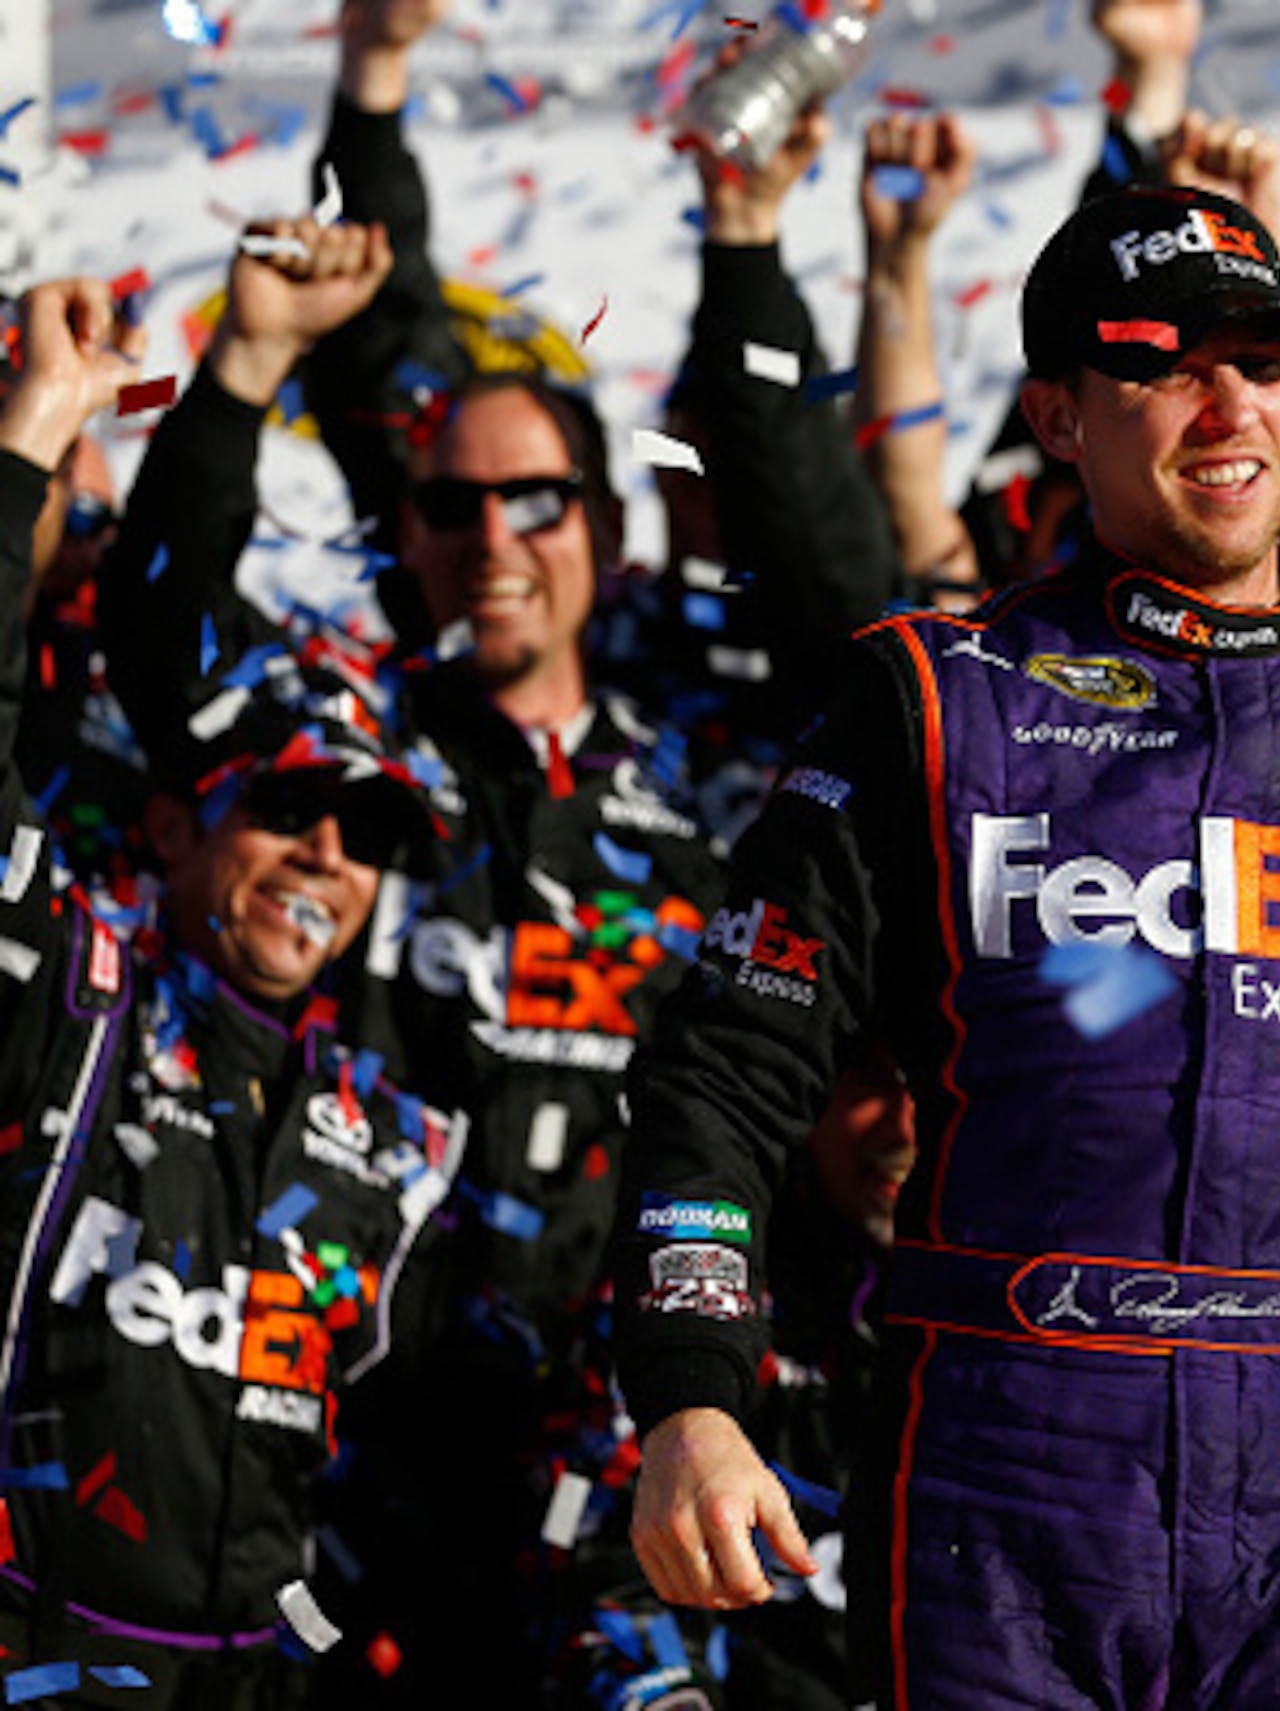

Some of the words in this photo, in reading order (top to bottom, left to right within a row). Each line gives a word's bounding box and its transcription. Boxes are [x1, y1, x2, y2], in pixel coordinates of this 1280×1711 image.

[1109, 208, 1267, 283] FedEx
[1126, 591, 1214, 649] FedEx
[1012, 721, 1179, 757] GOODYEAR
[703, 897, 826, 972] edEx
